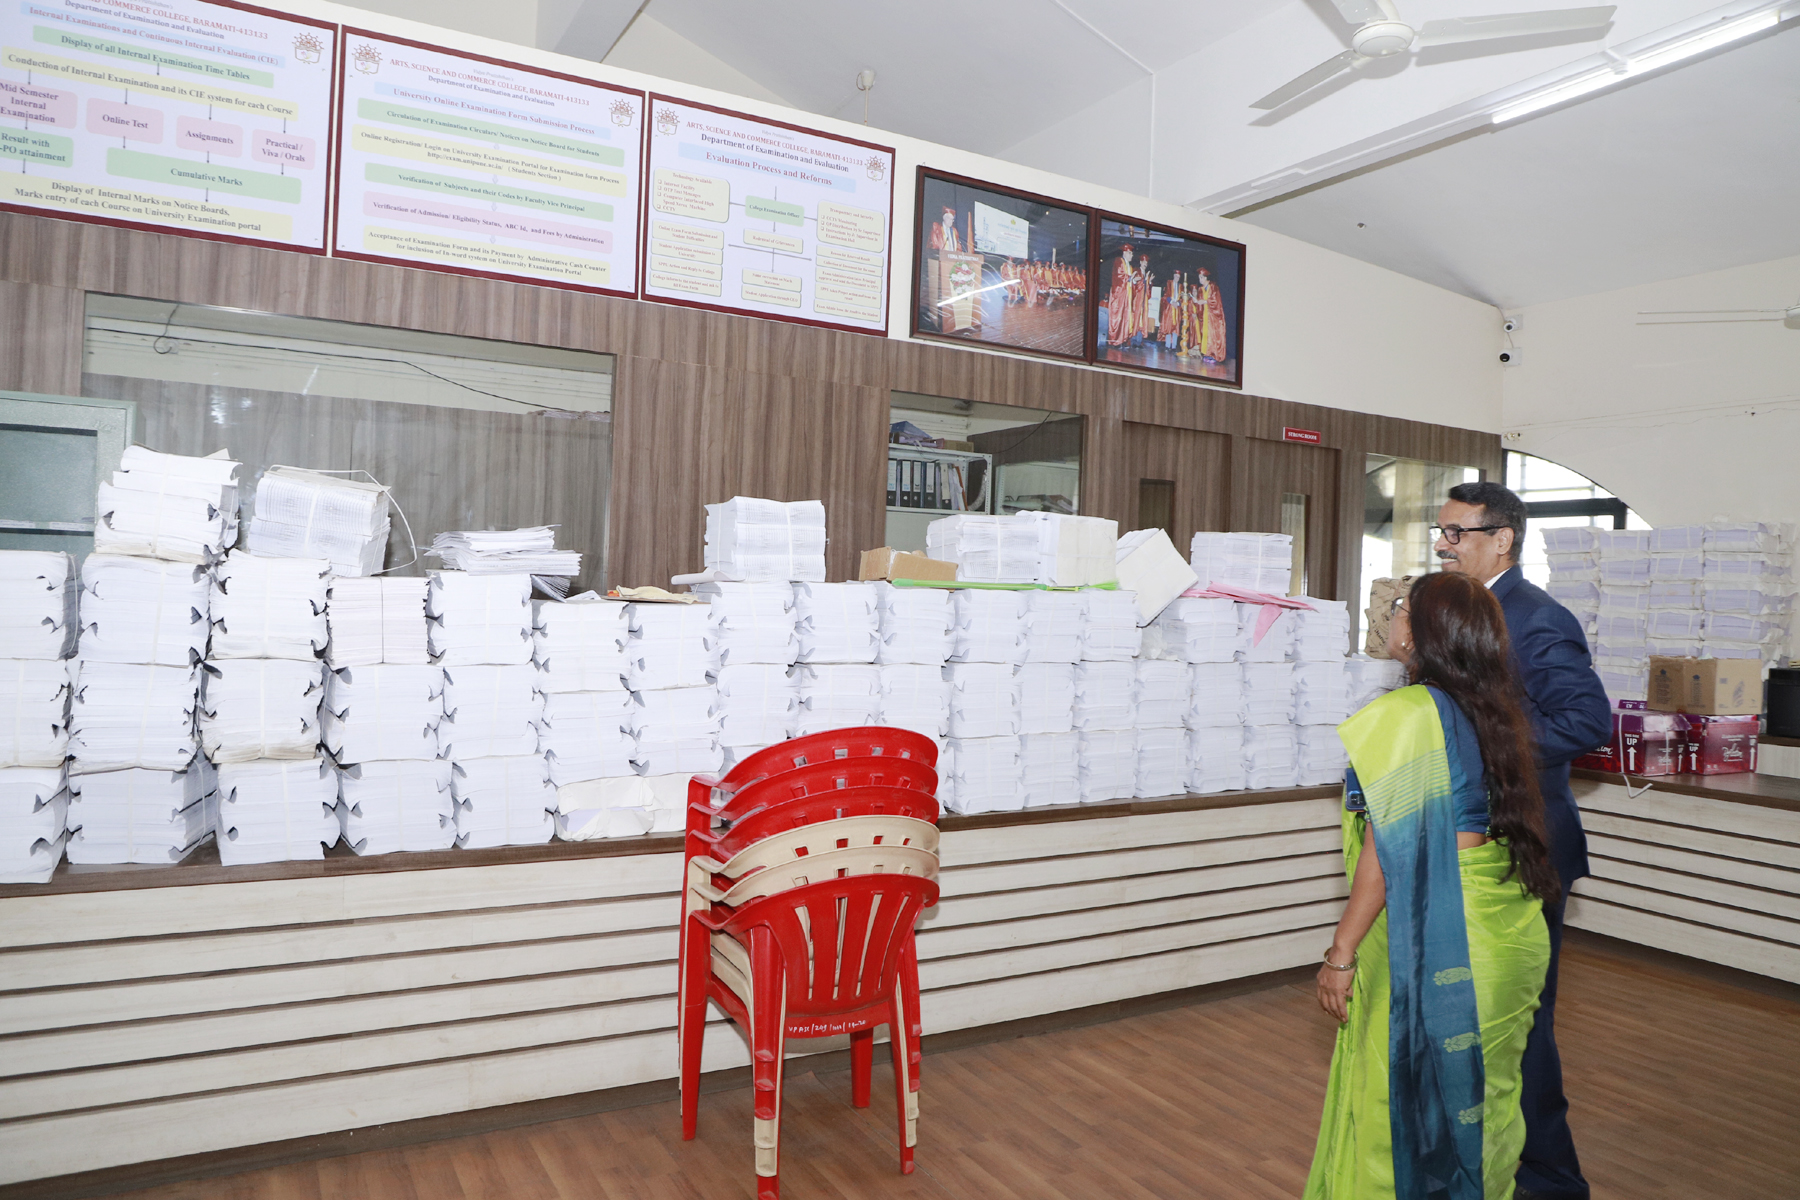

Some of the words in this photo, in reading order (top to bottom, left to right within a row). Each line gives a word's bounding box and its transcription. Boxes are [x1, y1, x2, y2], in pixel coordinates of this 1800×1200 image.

[65, 0, 111, 15] Department
[123, 12, 169, 27] Examination
[186, 26, 224, 39] Evaluation
[29, 6, 63, 21] Internal
[65, 14, 120, 32] Examinations
[122, 27, 137, 37] and
[139, 30, 183, 46] Continuous
[184, 40, 215, 52] Internal
[216, 46, 256, 60] Evaluation
[257, 55, 278, 66] (CIE)
[61, 35, 91, 50] Display
[94, 43, 104, 52] of
[105, 45, 115, 53] all
[117, 47, 150, 60] Internal
[152, 54, 202, 70] Examination
[205, 64, 224, 75] Time
[226, 68, 250, 80] Tables
[8, 54, 58, 70] Conduction
[71, 66, 105, 79] Internal
[108, 74, 158, 89] Examination
[178, 87, 187, 95] its
[188, 89, 205, 98] CIE
[207, 94, 233, 104] system
[234, 97, 246, 106] for
[247, 102, 264, 110] each
[266, 104, 292, 115] Course
[411, 63, 440, 74] SCIENCE
[441, 69, 457, 77] AND
[457, 72, 495, 86] COMMERCE
[0, 82, 16, 92] Mid
[20, 88, 58, 100] Semester
[428, 76, 465, 87] Department
[473, 85, 510, 97] Examination
[524, 95, 554, 106] Evaluation
[11, 97, 46, 109] Internal
[393, 88, 431, 103] University
[433, 96, 458, 107] Online
[461, 101, 506, 116] Examination
[508, 111, 527, 121] Form
[529, 116, 568, 129] Submission
[570, 124, 594, 134] Process
[0, 108, 55, 123] Examination
[102, 114, 130, 125] Online
[132, 119, 148, 128] Test
[1, 133, 28, 144] Result
[31, 139, 49, 147] with
[186, 131, 233, 144] Assignments
[266, 138, 298, 150] Practical
[705, 125, 730, 136] SCIENCE
[732, 131, 746, 139] AND
[746, 134, 780, 147] COMMERCE
[20, 149, 65, 161] attainment
[262, 148, 278, 157] Viva
[284, 152, 305, 162] Orals
[701, 134, 745, 149] Department
[755, 146, 798, 160] Examination
[799, 156, 812, 164] and
[814, 158, 848, 172] Evaluation
[170, 168, 215, 181] Cumulative
[218, 175, 242, 185] Marks
[511, 167, 536, 176] Students
[537, 172, 558, 180] Section
[706, 152, 750, 167] Evaluation
[752, 161, 781, 174] Process
[800, 172, 832, 185] Reforms
[52, 182, 82, 194] Display
[84, 187, 94, 195] of
[98, 189, 131, 200] Internal
[133, 194, 160, 205] Marks
[174, 200, 198, 211] Notice
[15, 188, 42, 198] Marks
[45, 194, 67, 204] entry
[101, 201, 130, 212] Course
[145, 207, 185, 219] University
[187, 214, 236, 227] Examination
[237, 222, 261, 231] portal
[1626, 738, 1638, 746] UP
